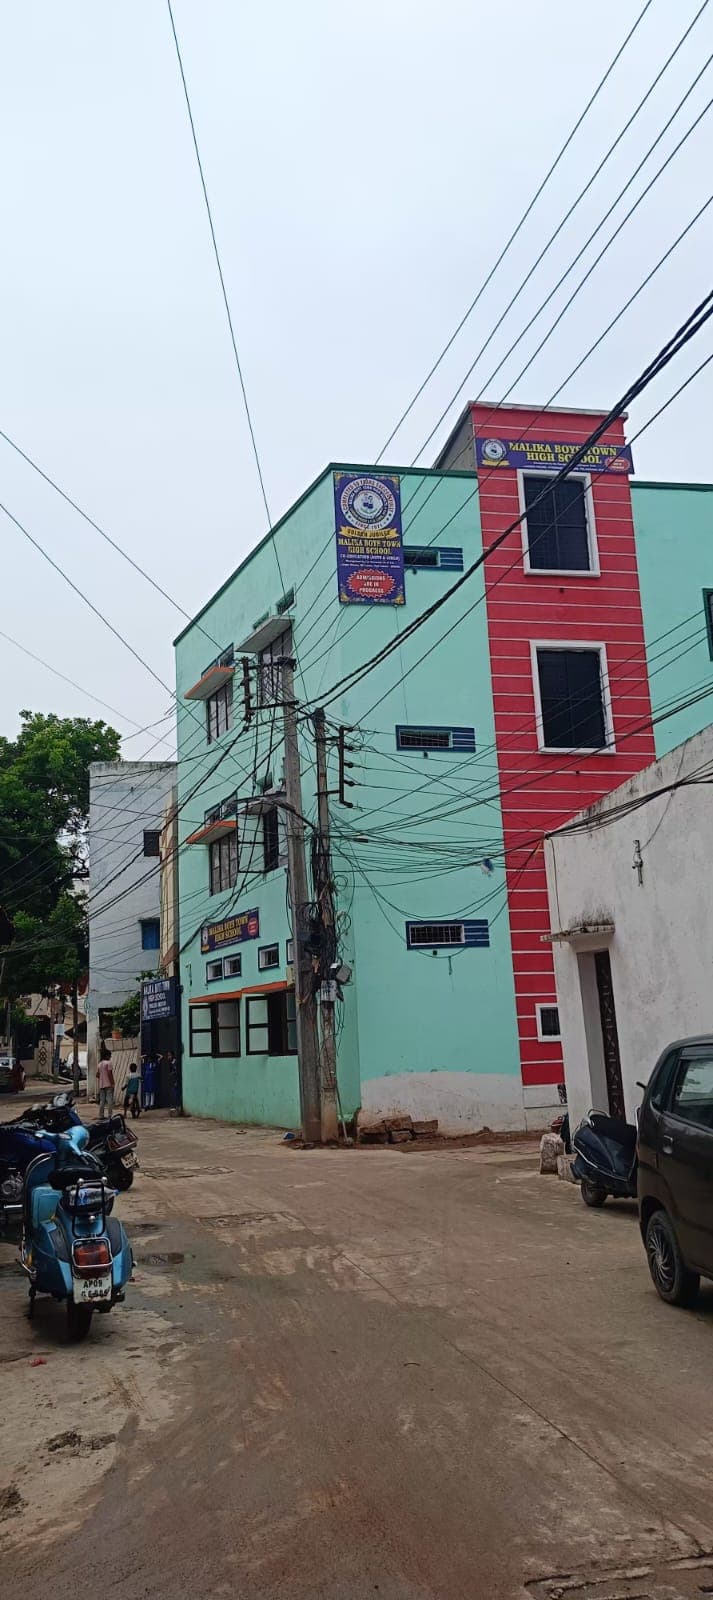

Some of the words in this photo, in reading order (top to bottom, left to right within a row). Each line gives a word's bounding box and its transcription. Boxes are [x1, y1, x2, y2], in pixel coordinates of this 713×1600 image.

[508, 442, 552, 452] MALIKA
[527, 452, 554, 462] HIGH
[338, 538, 363, 546] MALIKA
[383, 540, 401, 548] TOWN
[348, 546, 365, 554] HIGH
[366, 547, 392, 555] SCHOOL
